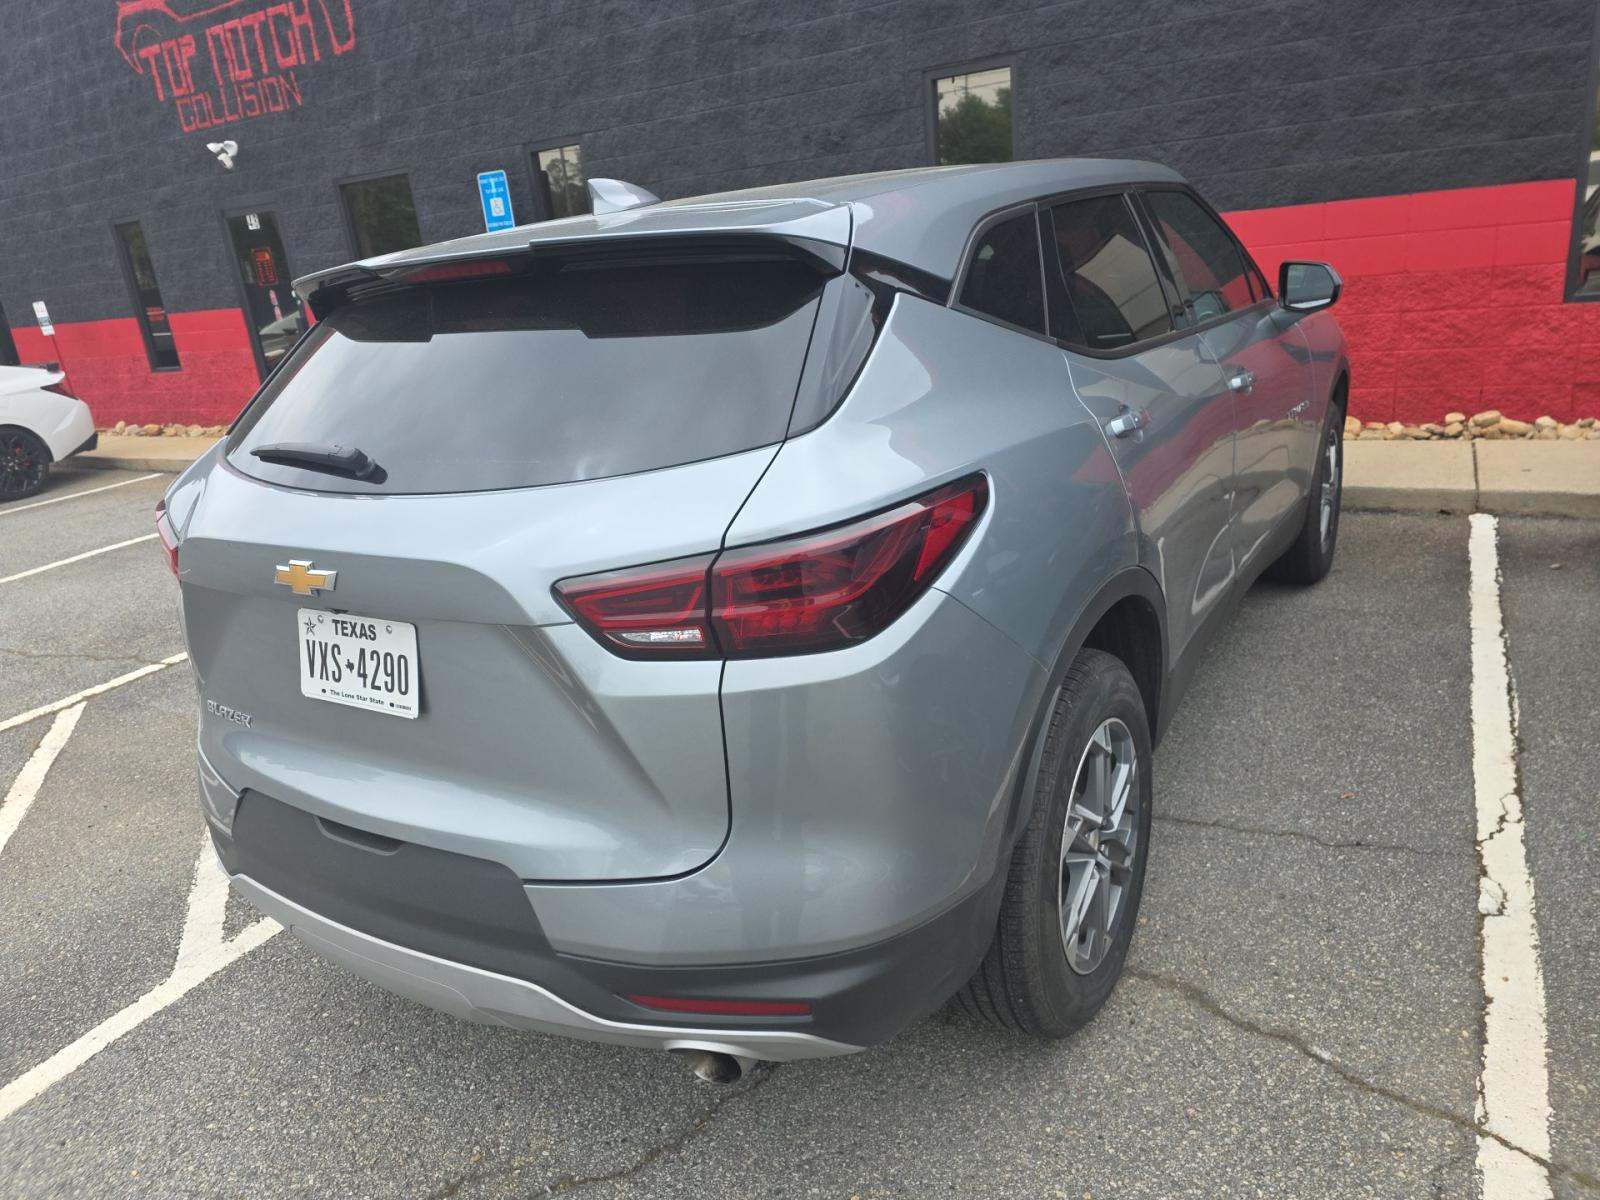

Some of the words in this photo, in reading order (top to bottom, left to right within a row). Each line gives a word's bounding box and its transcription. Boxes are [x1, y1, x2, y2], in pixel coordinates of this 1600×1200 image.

[139, 34, 196, 101] TOP
[206, 0, 321, 90] NOTCH
[175, 71, 302, 133] COLLISION
[332, 619, 377, 641] TEXAS
[306, 639, 342, 683] VXS
[357, 647, 409, 696] 4290
[207, 699, 251, 729] BLAZER
[330, 689, 340, 697] The
[341, 691, 355, 699] Lone
[369, 697, 385, 705] State
